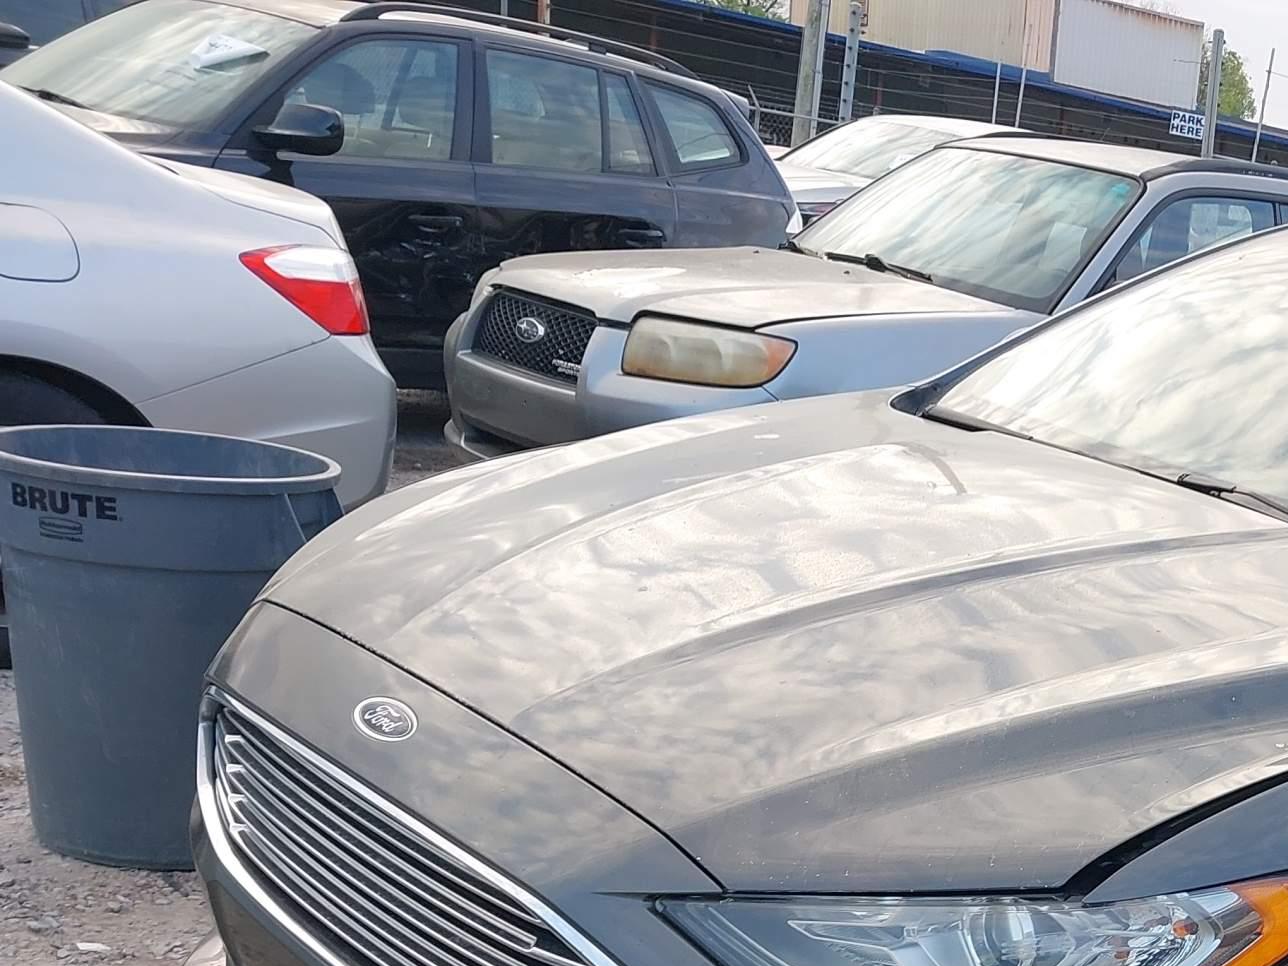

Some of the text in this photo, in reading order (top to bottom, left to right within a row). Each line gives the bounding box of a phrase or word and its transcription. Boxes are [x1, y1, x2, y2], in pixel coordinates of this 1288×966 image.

[1170, 122, 1203, 137] HERE
[1172, 111, 1205, 127] PARK
[11, 482, 118, 521] BRUTE
[363, 705, 403, 732] Ford
